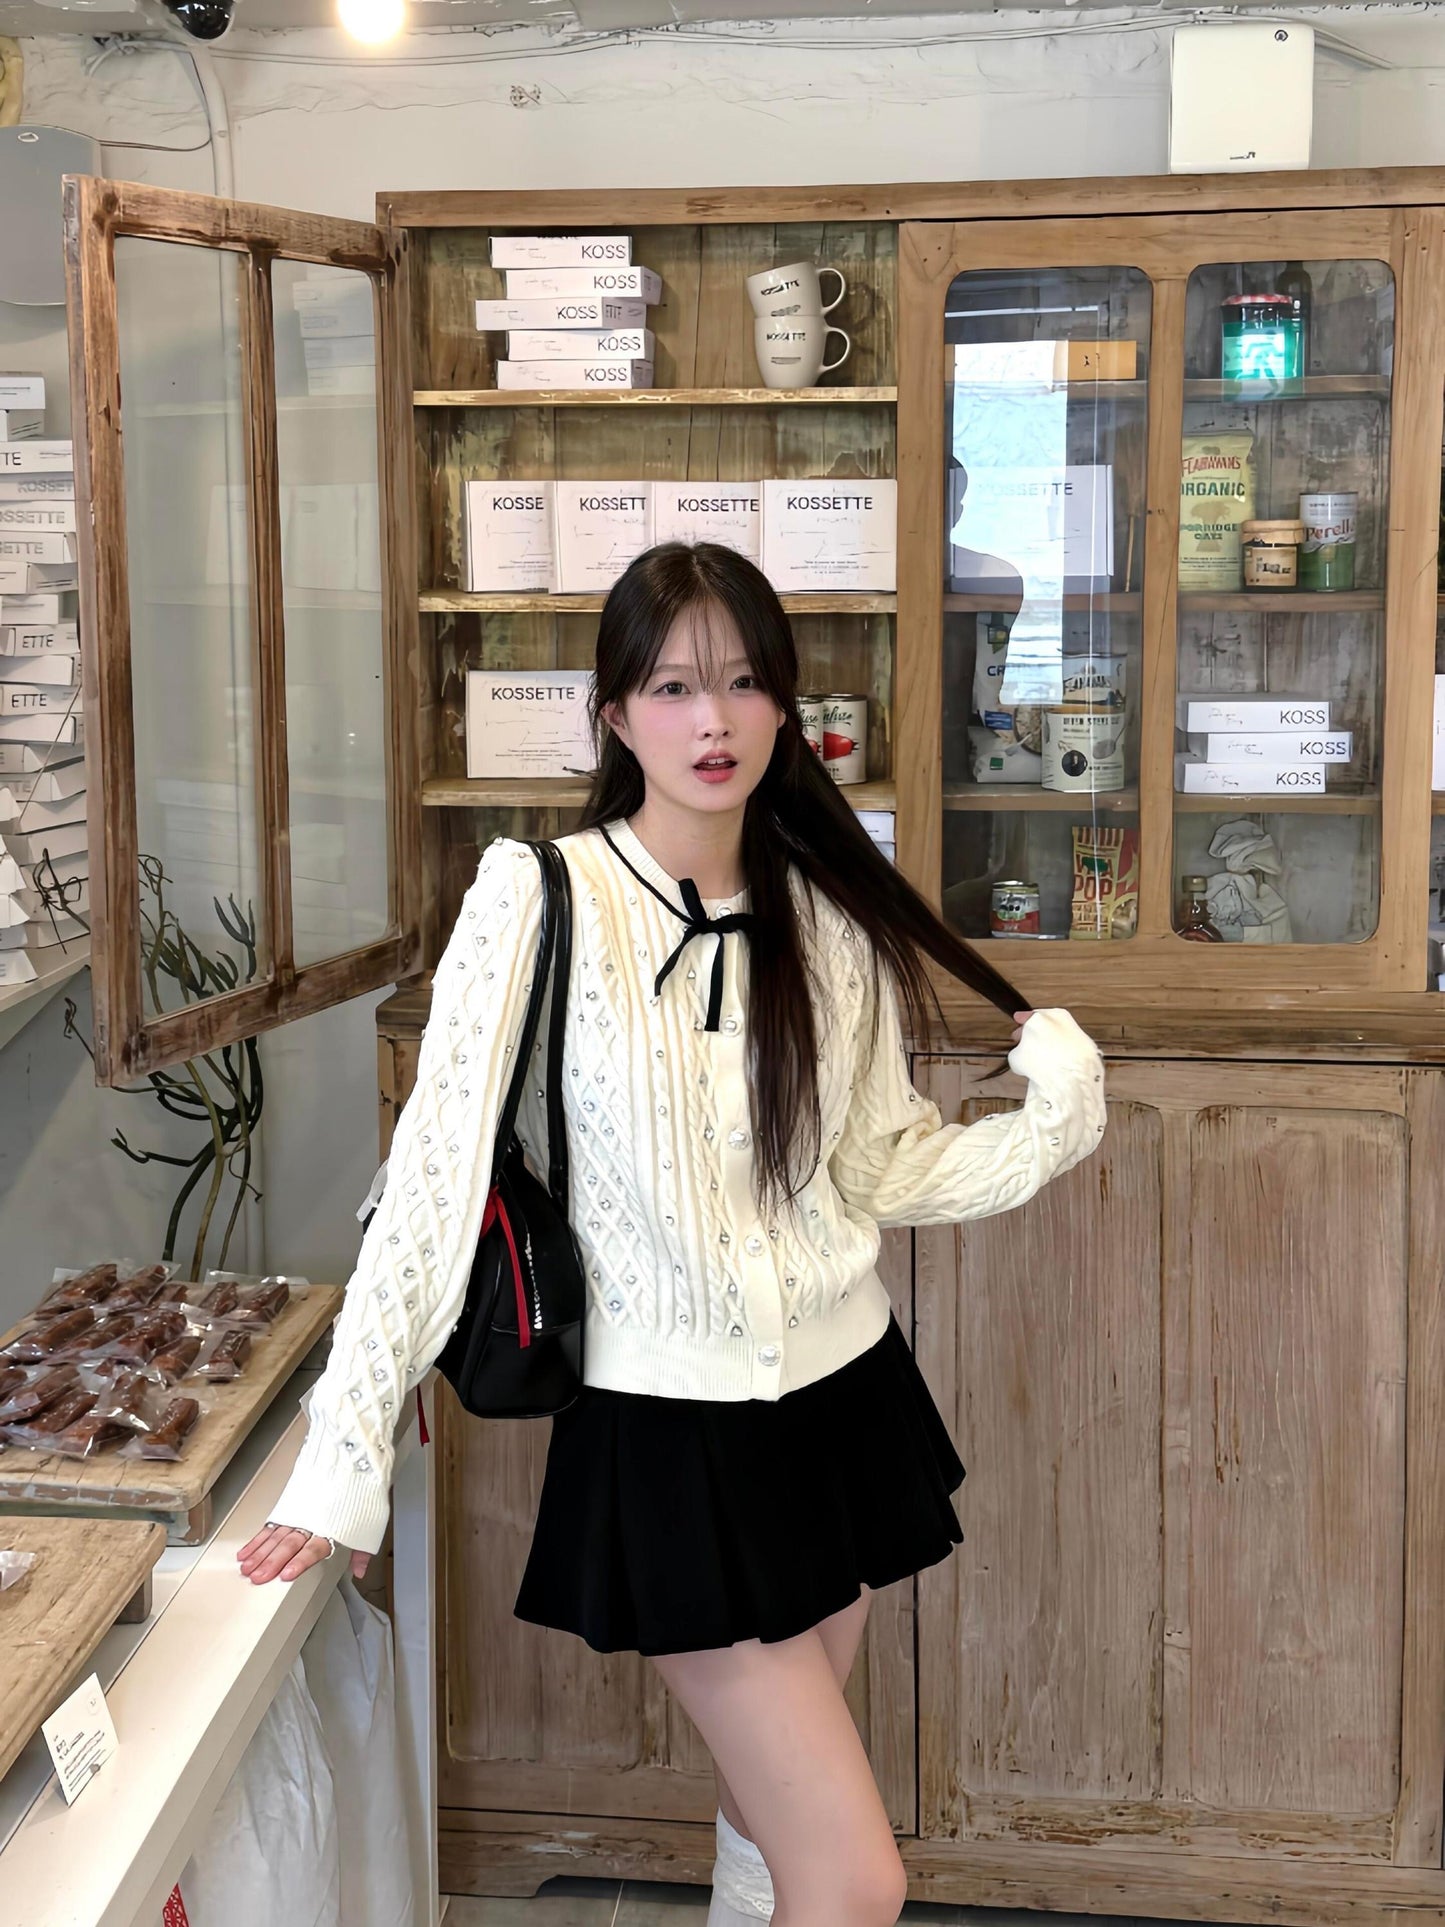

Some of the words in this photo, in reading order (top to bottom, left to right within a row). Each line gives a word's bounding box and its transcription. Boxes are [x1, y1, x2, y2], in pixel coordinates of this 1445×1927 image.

[581, 245, 627, 259] KOSS
[593, 275, 638, 289] KOSS
[557, 305, 599, 320] KOSS
[597, 337, 641, 351] KOSS
[584, 368, 628, 382] KOSS
[493, 497, 545, 511] KOSSE
[580, 497, 647, 511] KOSSETT
[677, 498, 760, 512] KOSSETTE
[786, 496, 873, 510] KOSSETTE
[491, 687, 576, 701] KOSSETTE
[1280, 710, 1326, 725] KOSS
[1300, 741, 1347, 755] KOSS
[1276, 772, 1322, 786] KOSS
